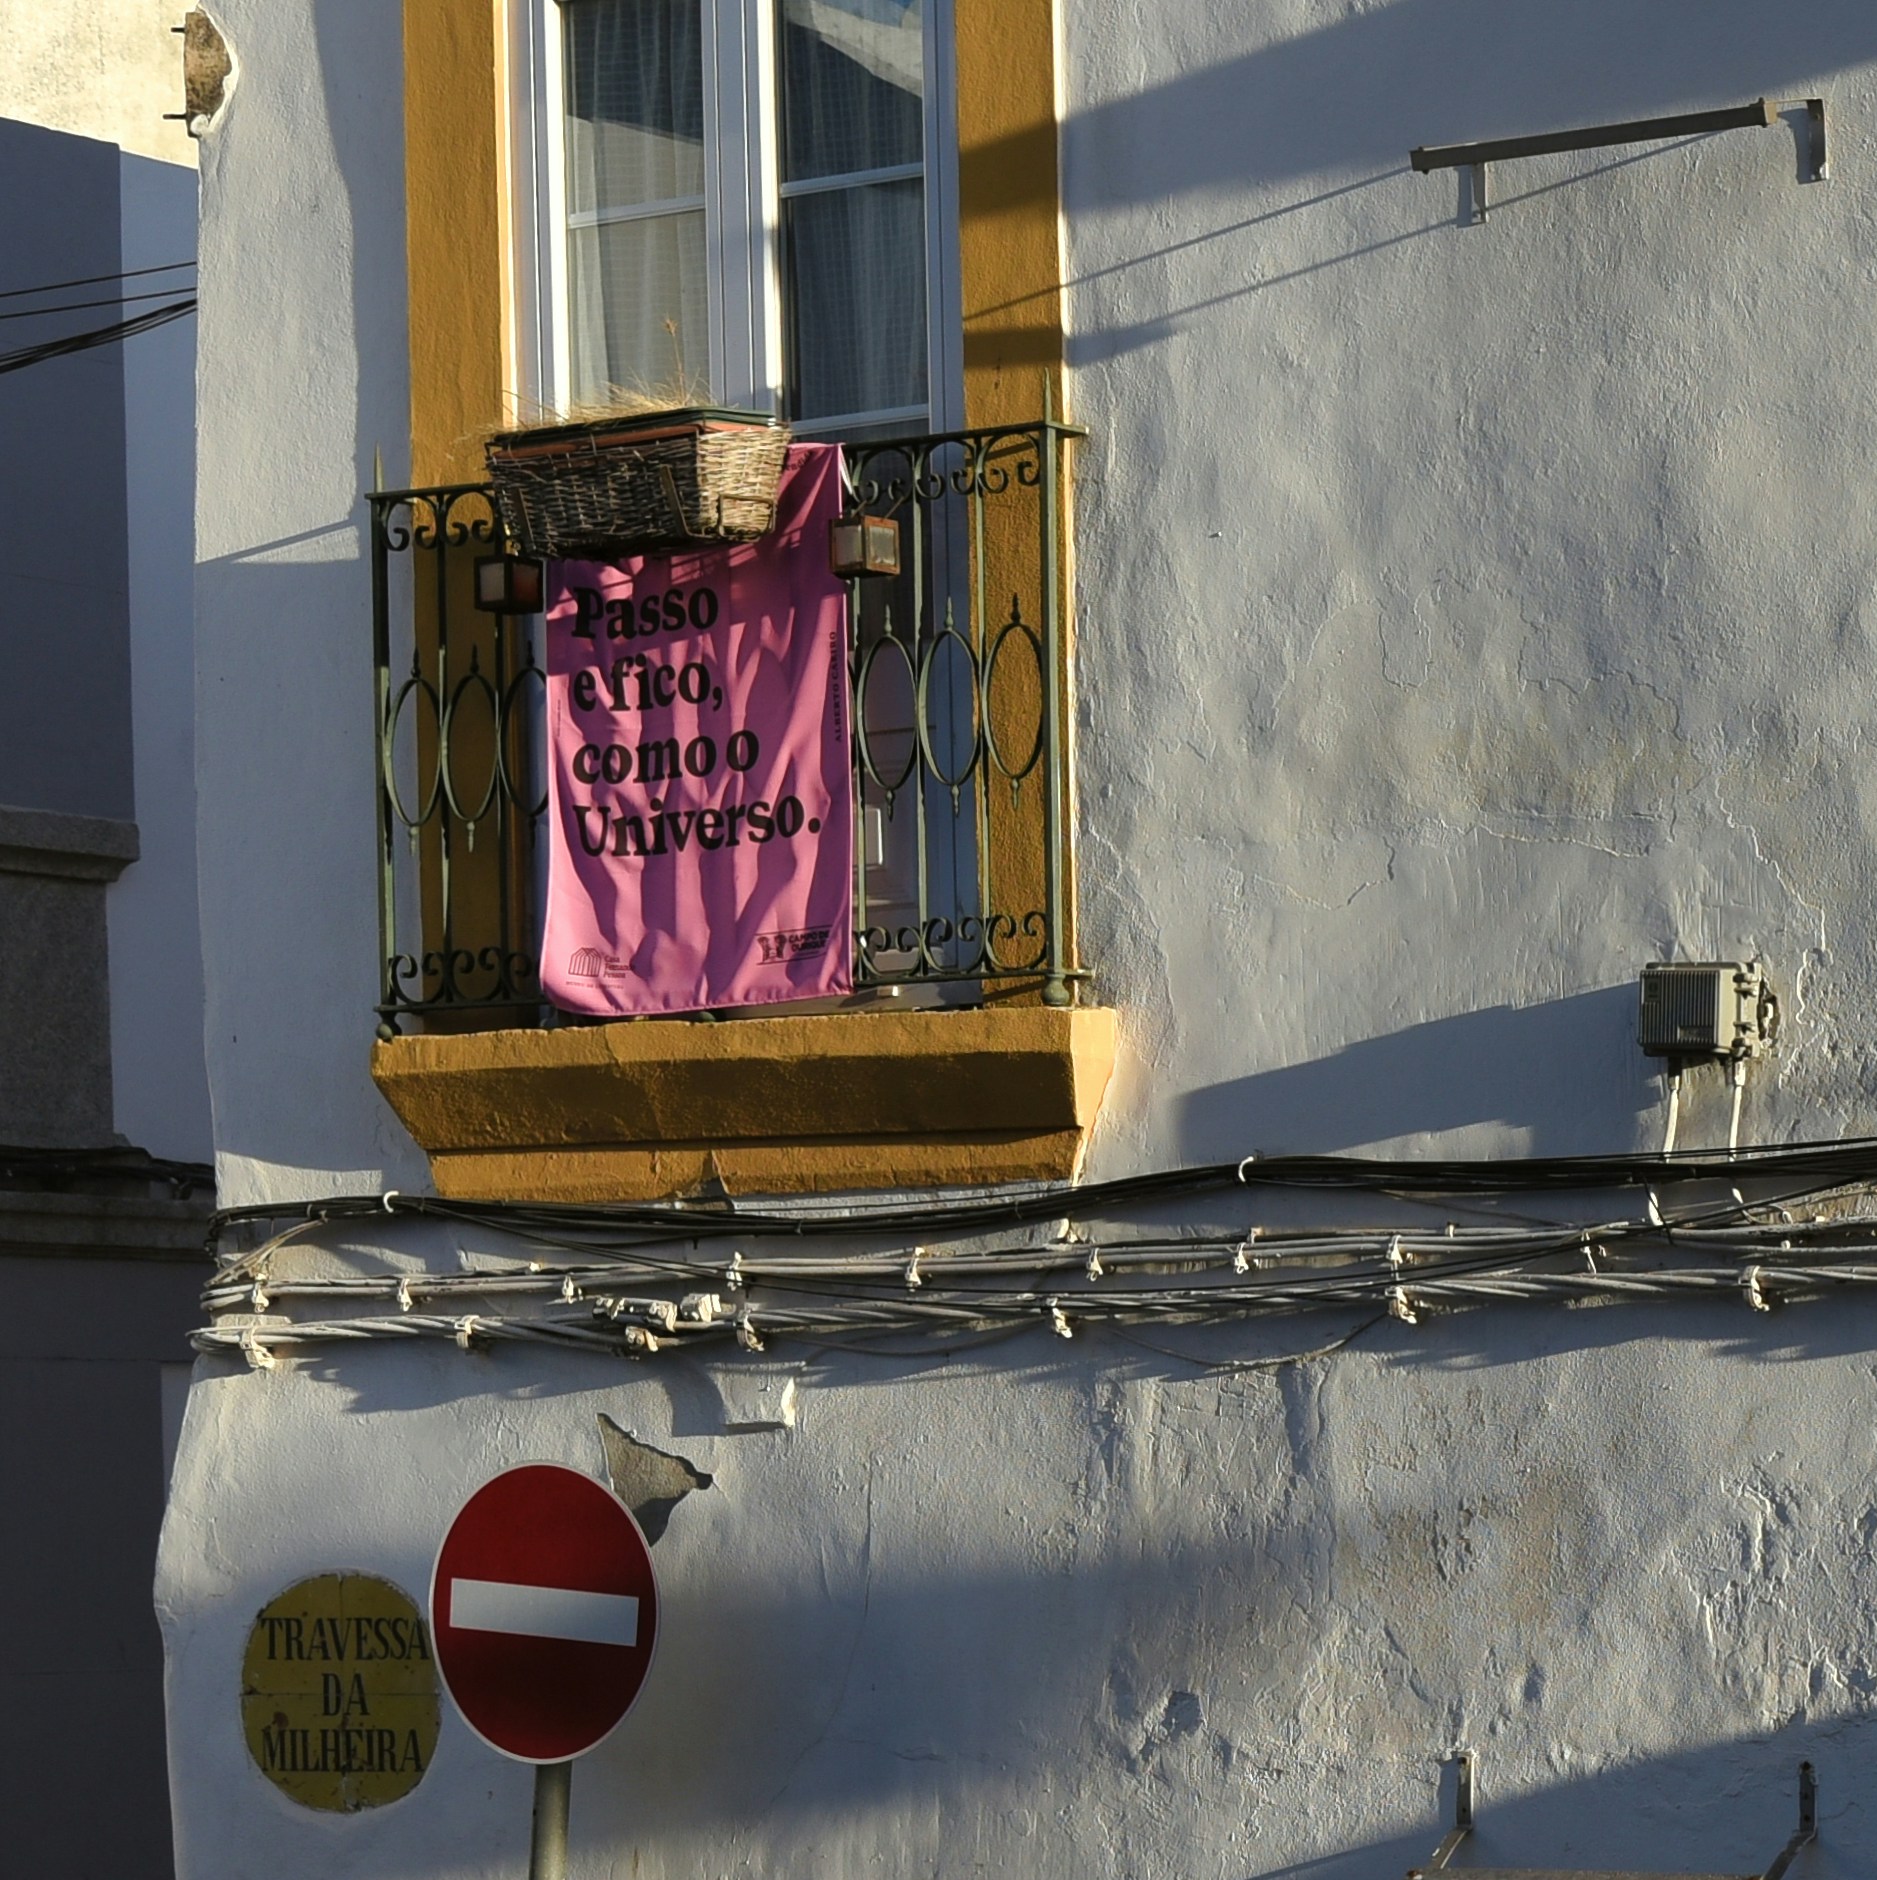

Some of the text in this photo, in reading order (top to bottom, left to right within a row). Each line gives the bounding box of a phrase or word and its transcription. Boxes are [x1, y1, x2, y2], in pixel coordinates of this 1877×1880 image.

[571, 586, 718, 639] Passo
[574, 652, 723, 712] e fico,
[832, 683, 843, 743] ALBERTO
[573, 730, 760, 785] como o
[572, 795, 821, 857] Universo.
[789, 931, 817, 943] CAMPO
[260, 1616, 430, 1661] TRAVESSA
[321, 1672, 370, 1716] DA
[261, 1728, 425, 1773] MILHEIRA
